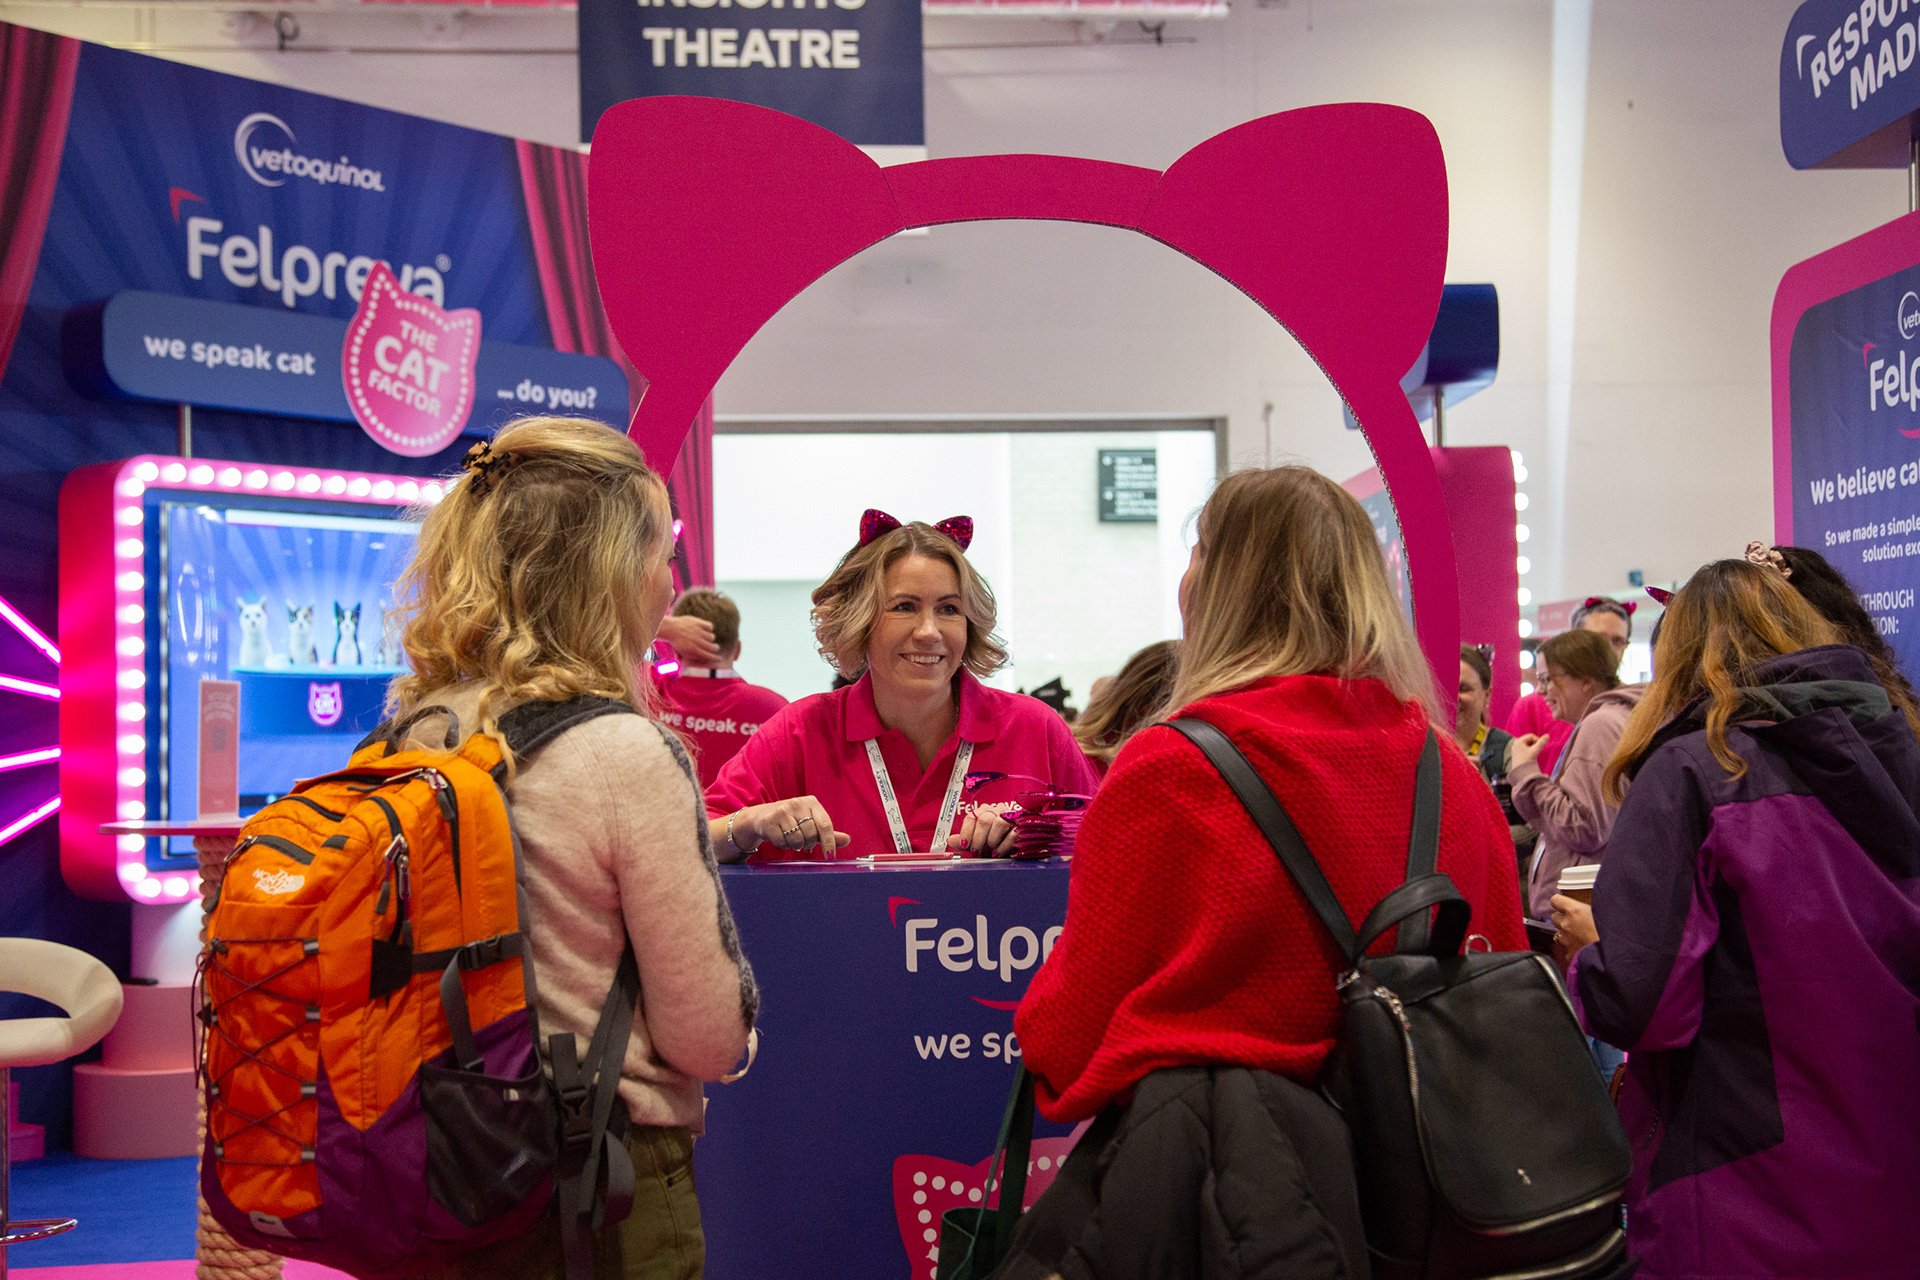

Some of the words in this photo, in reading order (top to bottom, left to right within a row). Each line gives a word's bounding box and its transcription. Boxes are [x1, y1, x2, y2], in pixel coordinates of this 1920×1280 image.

[642, 27, 861, 69] THEATRE
[1810, 0, 1920, 99] RESPO
[1850, 16, 1920, 110] MAD
[400, 320, 438, 353] THE
[1903, 309, 1920, 330] vet
[143, 335, 186, 360] we
[191, 342, 272, 368] speak
[276, 351, 316, 376] cat
[374, 336, 450, 393] CAT
[368, 369, 441, 417] FACTOR
[516, 379, 545, 404] do
[548, 386, 597, 410] you?
[1810, 478, 1835, 506] We
[1837, 466, 1896, 500] believe
[1899, 457, 1920, 487] ca
[1825, 530, 1836, 547] So
[1837, 526, 1851, 544] we
[1852, 521, 1878, 542] made
[1880, 524, 1886, 537] a
[1887, 513, 1920, 536] simple
[1862, 541, 1903, 564] solution
[1859, 588, 1915, 612] THROUGH
[659, 710, 684, 726] we
[685, 715, 737, 735] speak
[739, 722, 763, 736] ca
[946, 790, 958, 824] WOODLEY
[913, 1033, 971, 1060] we
